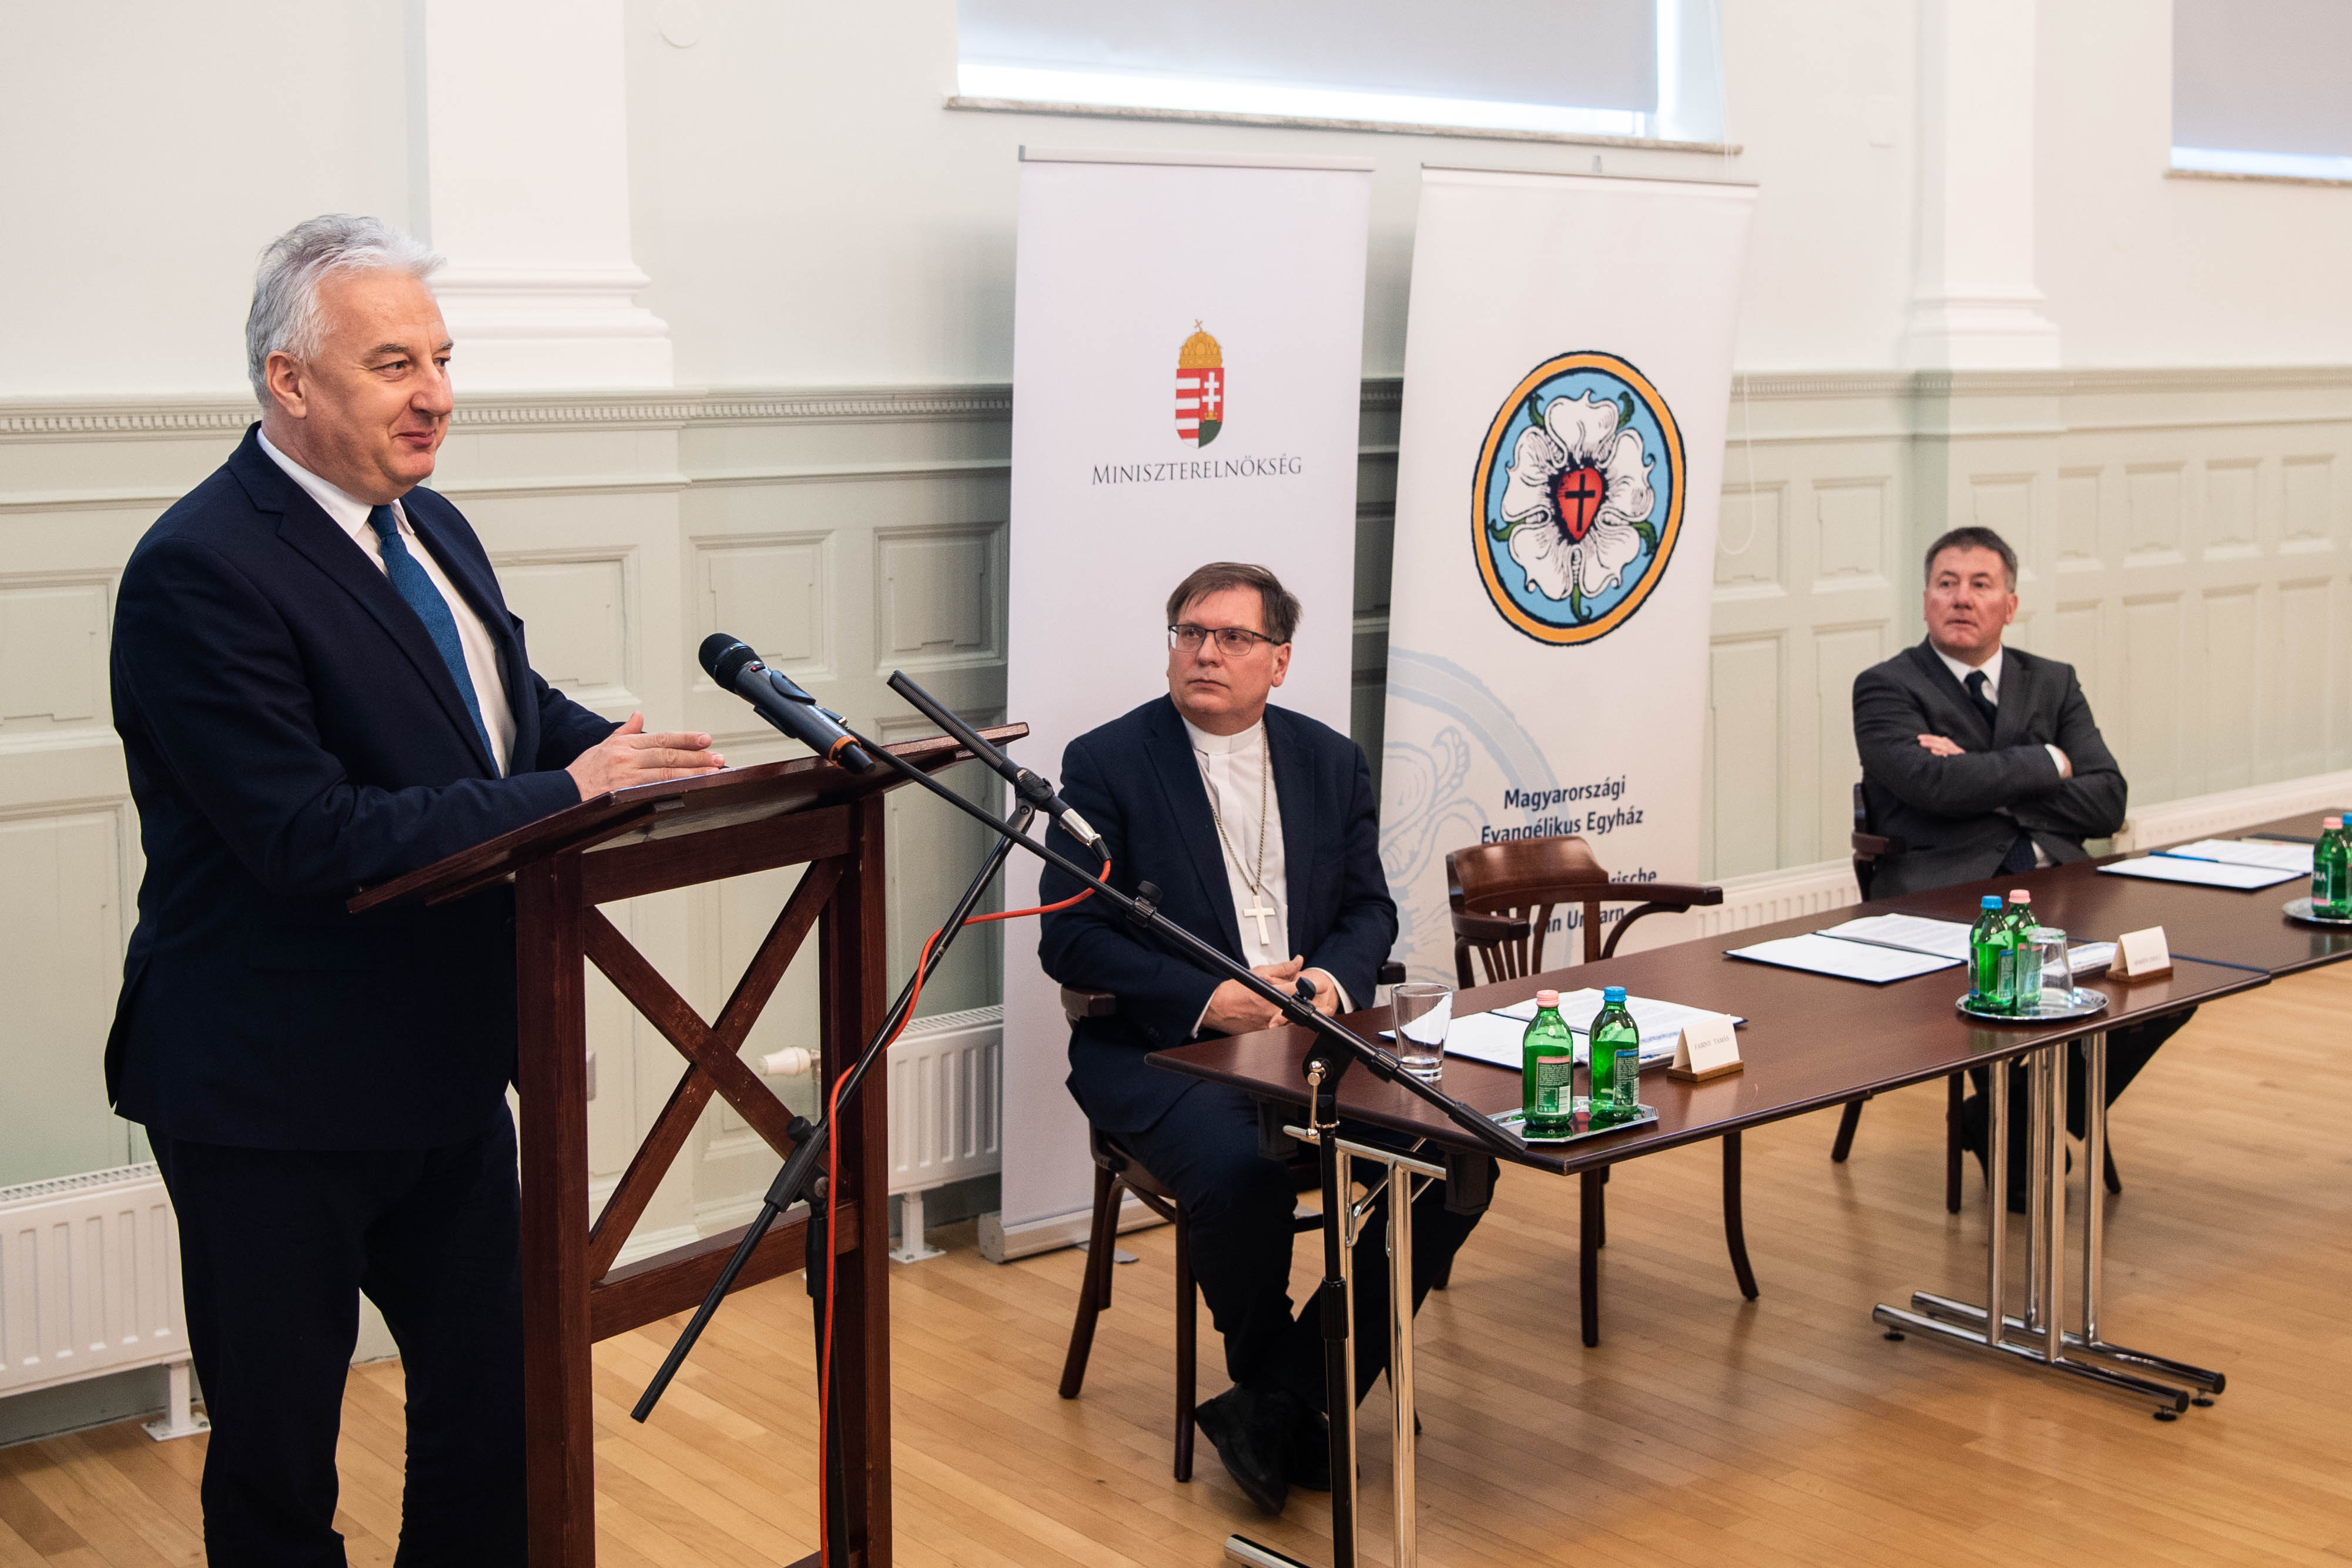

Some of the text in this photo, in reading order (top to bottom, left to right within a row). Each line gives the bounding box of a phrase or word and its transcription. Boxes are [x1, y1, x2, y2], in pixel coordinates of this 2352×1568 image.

[1092, 453, 1302, 485] MINISZTERELNÖKSÉG
[1503, 775, 1626, 811] Magyarországi
[1481, 805, 1644, 844] Evangélikus Egyház
[1611, 867, 1657, 883] rische
